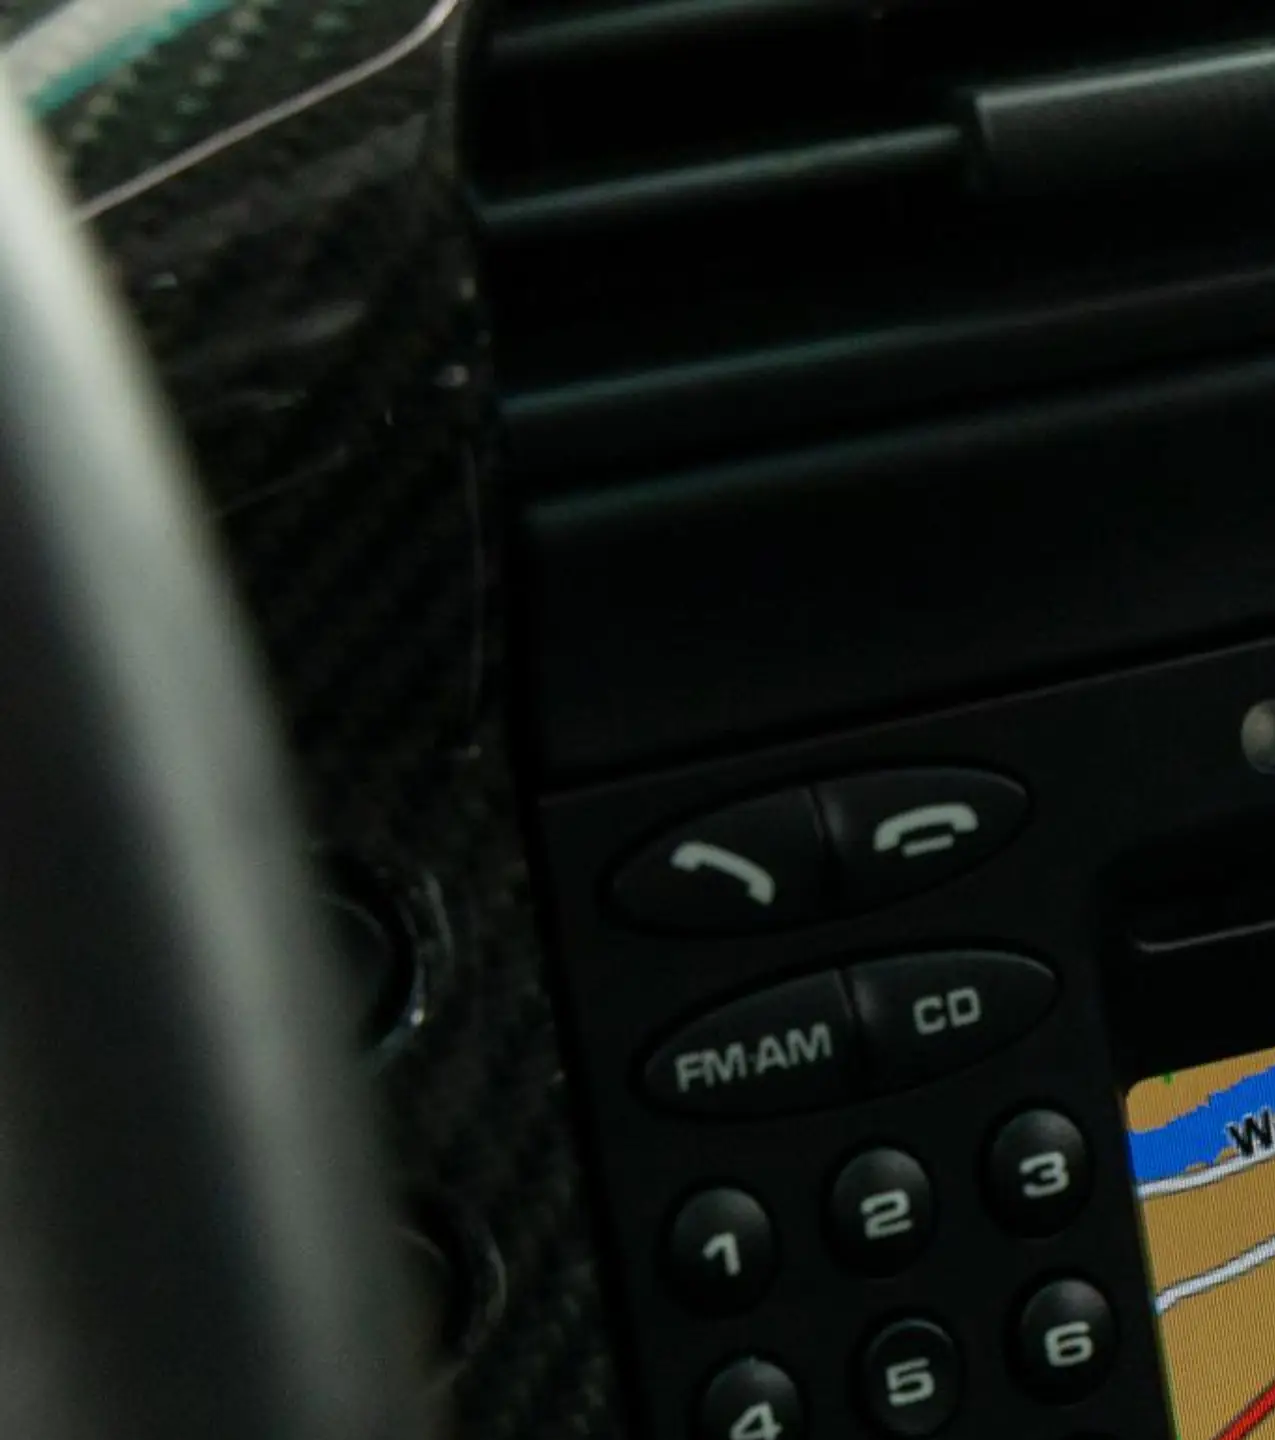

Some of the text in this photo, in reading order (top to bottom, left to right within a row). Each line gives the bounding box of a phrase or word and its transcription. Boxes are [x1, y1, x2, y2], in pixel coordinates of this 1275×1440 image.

[912, 986, 982, 1035] CD
[1019, 1151, 1071, 1198] 3
[861, 1189, 912, 1239] 2
[703, 1232, 741, 1276] 1
[1043, 1321, 1094, 1367] 6
[885, 1357, 936, 1407] 5
